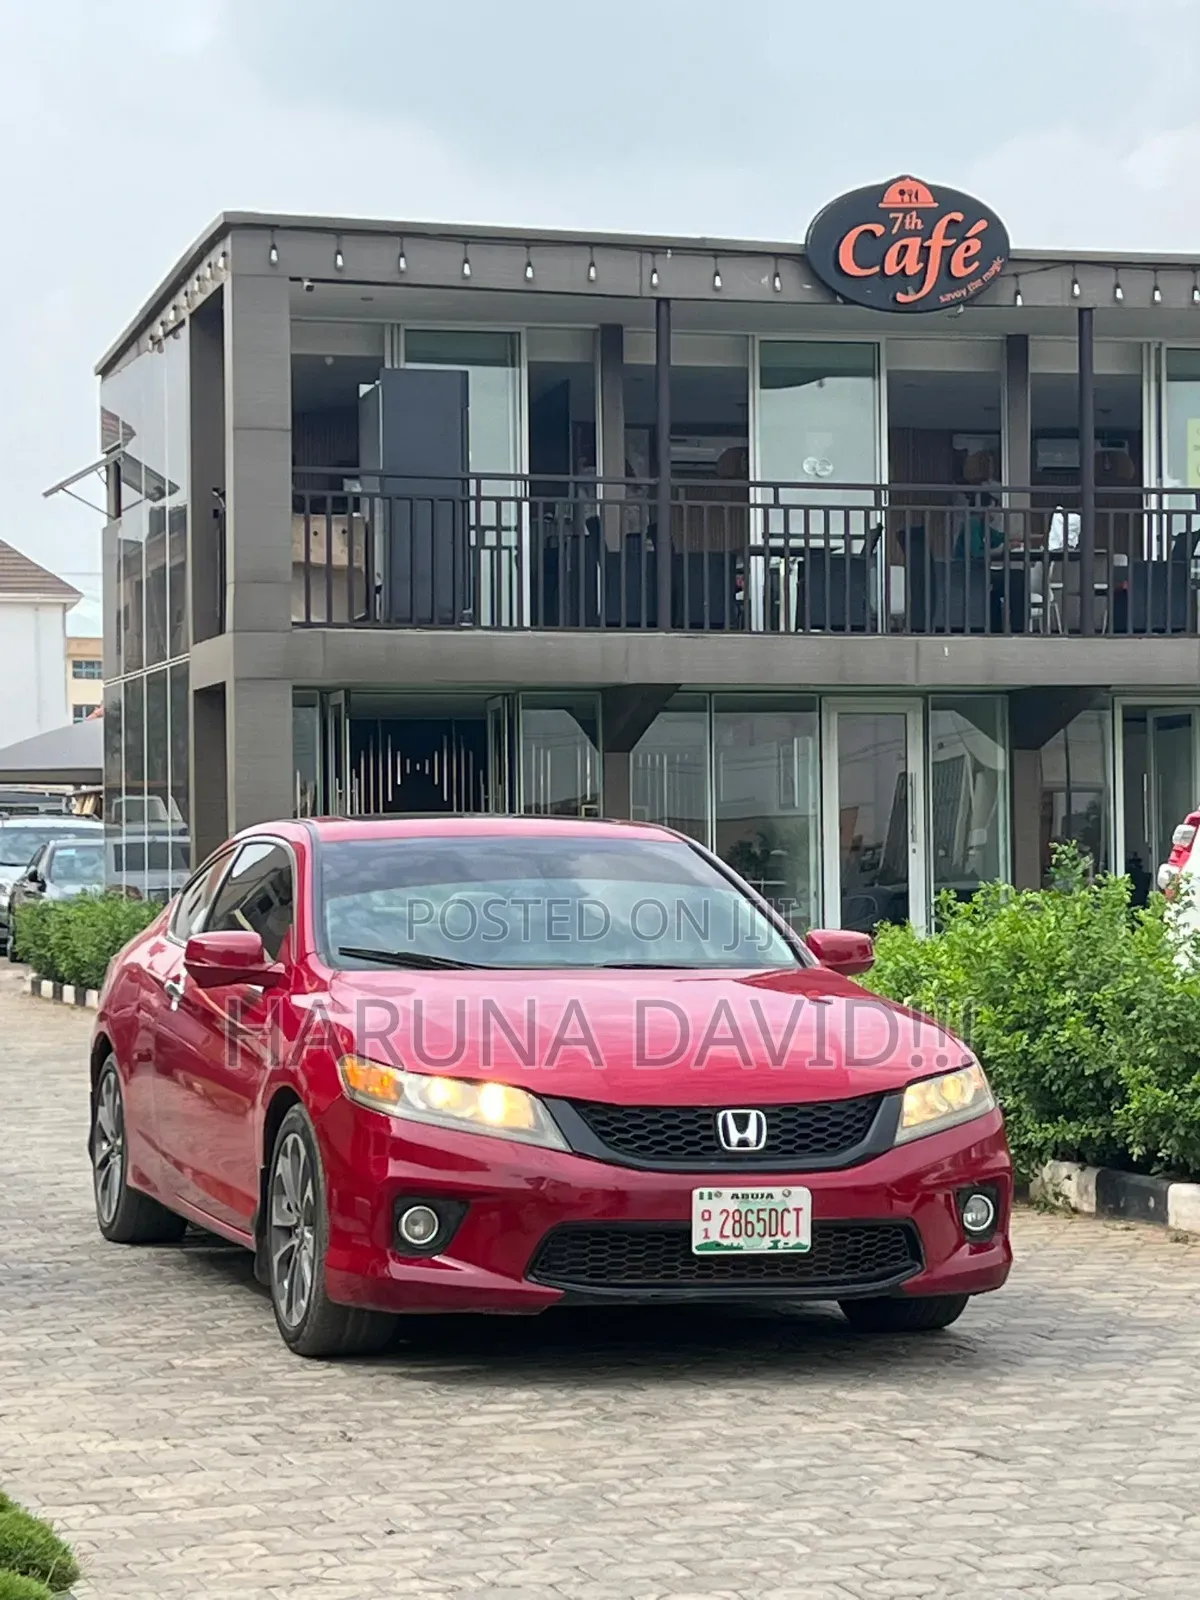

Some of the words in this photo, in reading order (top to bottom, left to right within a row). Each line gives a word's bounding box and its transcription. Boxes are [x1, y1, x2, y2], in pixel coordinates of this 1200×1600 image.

[889, 210, 924, 235] 7th
[838, 212, 988, 303] Café
[967, 278, 984, 292] the
[730, 1192, 775, 1200] ABUJA
[719, 1207, 803, 1239] 2865DCT
